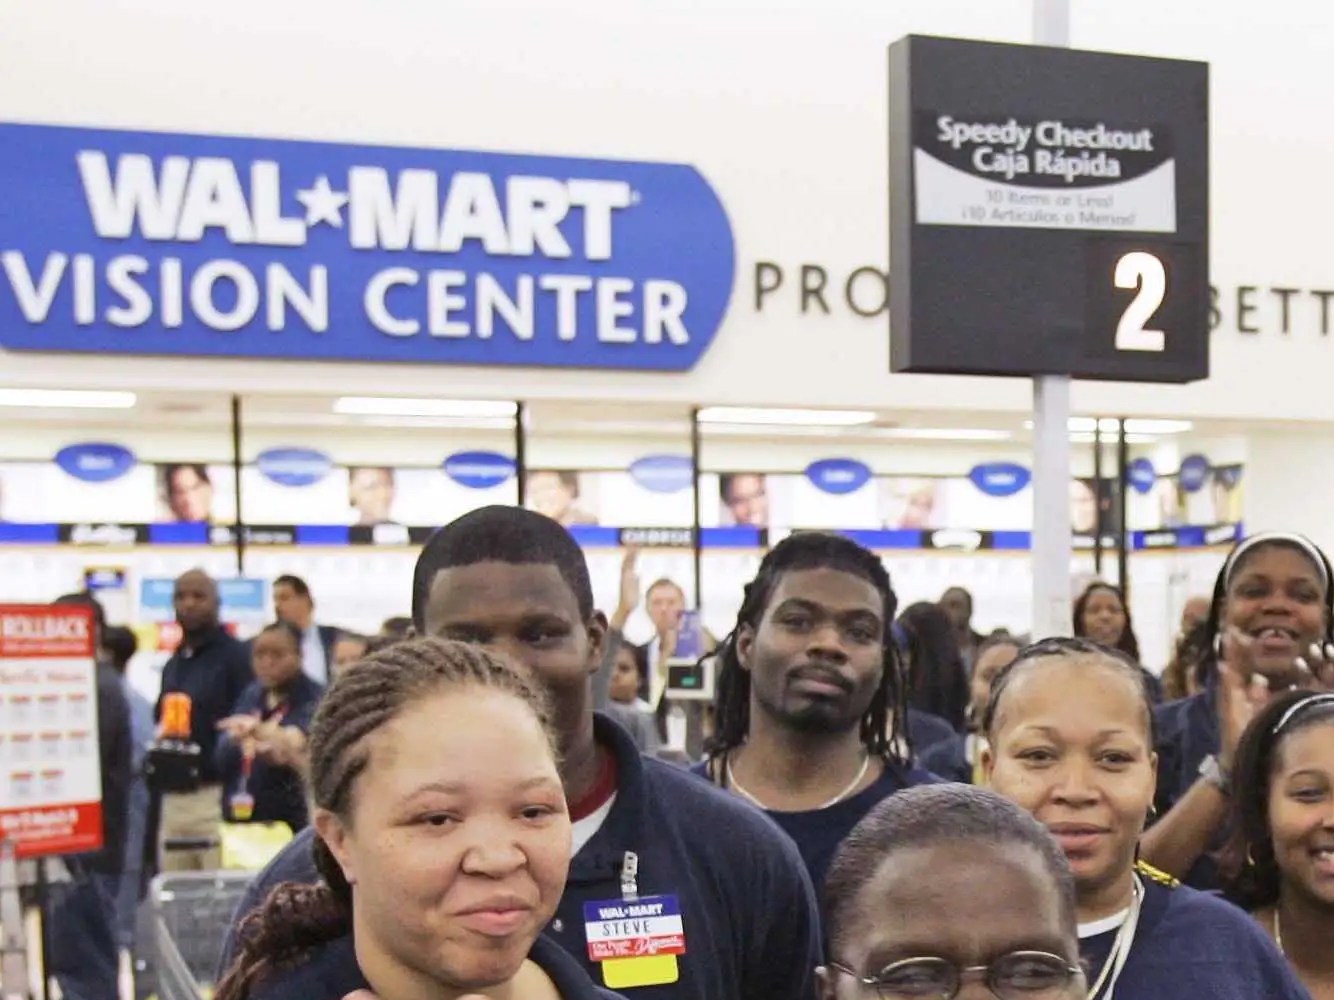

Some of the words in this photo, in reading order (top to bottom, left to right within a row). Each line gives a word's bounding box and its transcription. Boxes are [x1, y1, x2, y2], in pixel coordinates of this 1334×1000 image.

[936, 114, 1032, 151] Speedy
[1034, 120, 1154, 151] Checkout
[971, 145, 1030, 180] Caja
[1034, 148, 1122, 183] Rápida
[2, 250, 329, 333] VISION
[363, 266, 691, 346] CENTER
[1113, 251, 1166, 352] 2
[602, 920, 652, 937] STEVE
